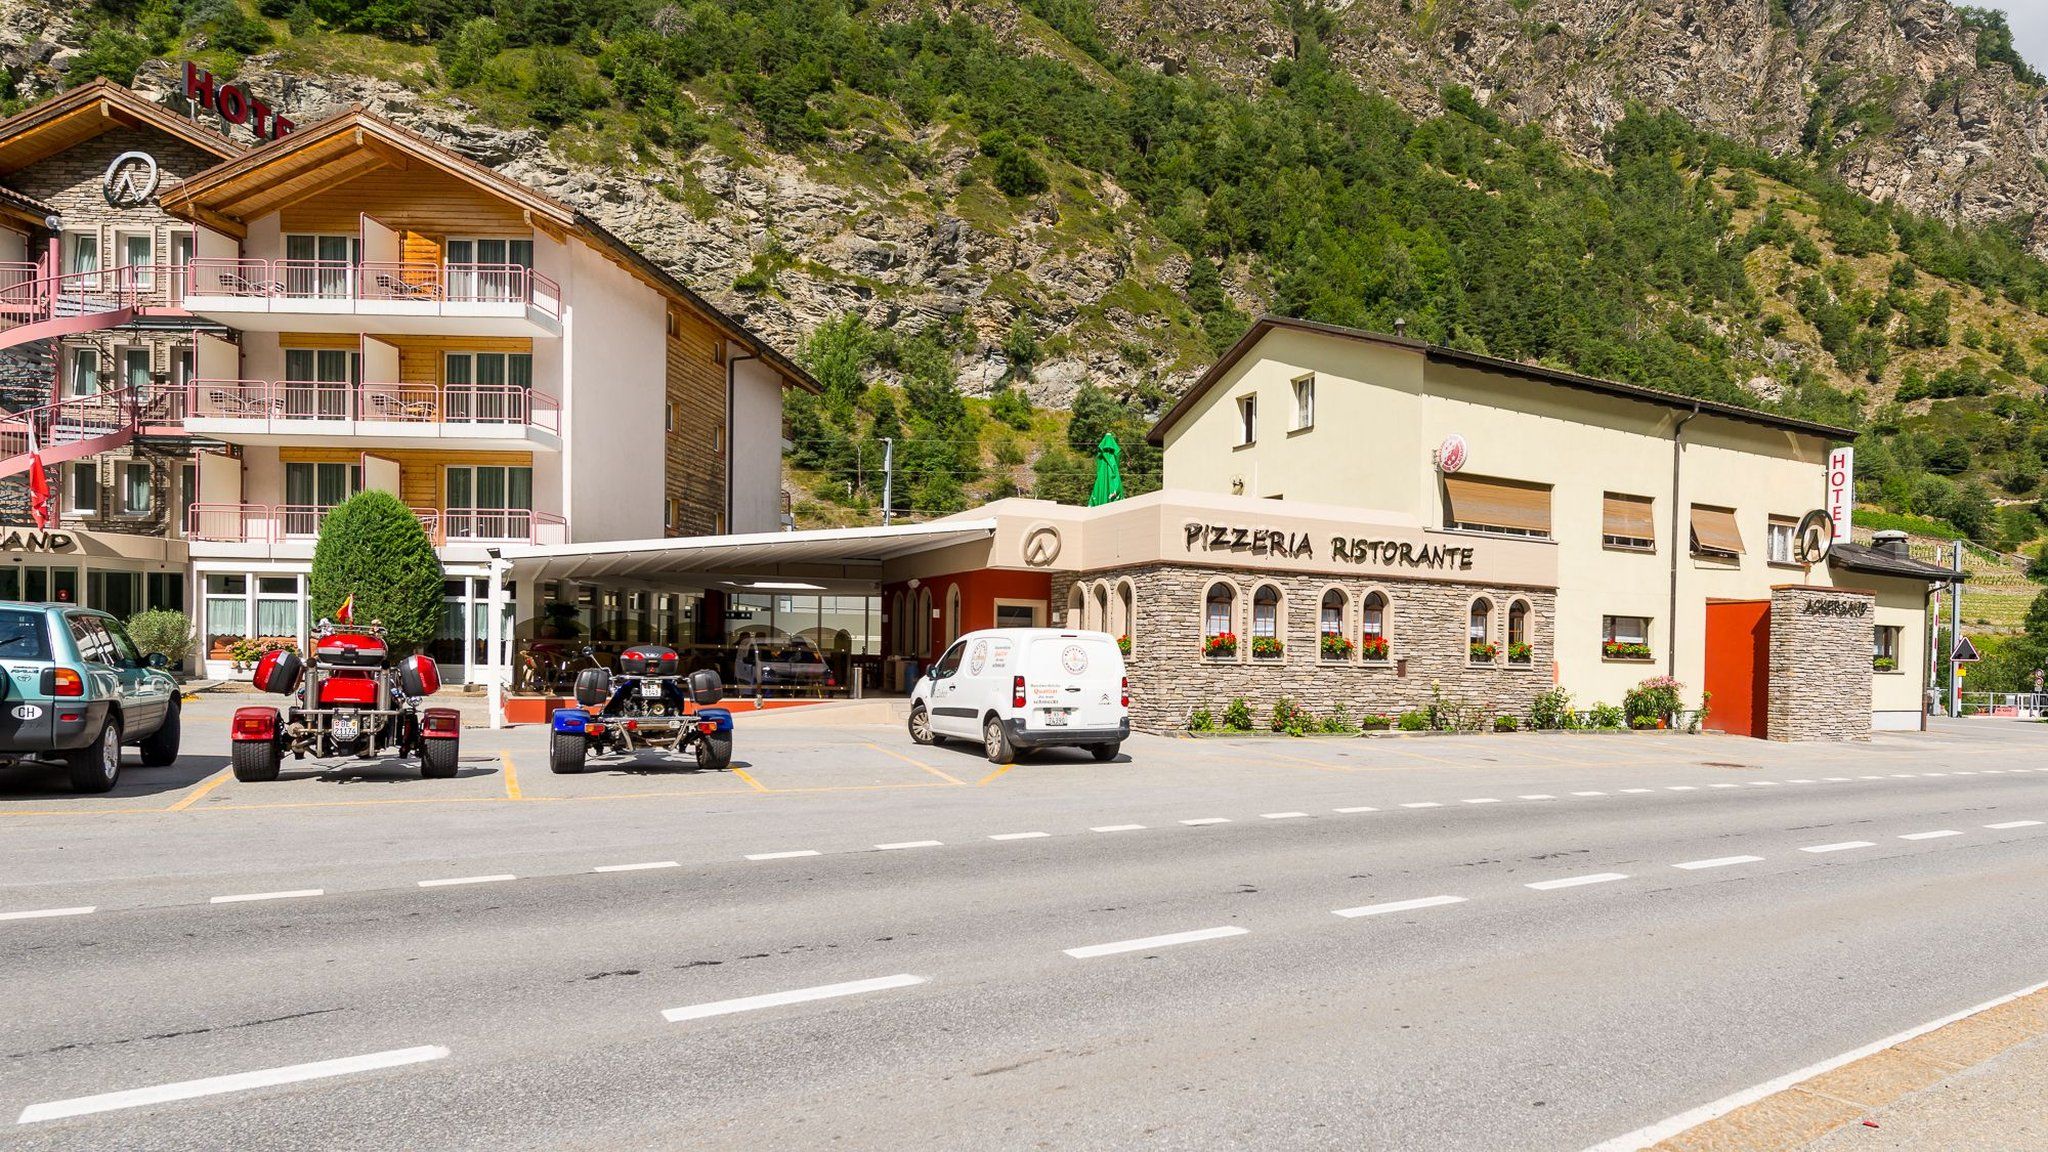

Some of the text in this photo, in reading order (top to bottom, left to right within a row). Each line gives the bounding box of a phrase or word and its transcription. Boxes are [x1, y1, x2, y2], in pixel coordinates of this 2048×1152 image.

[1831, 454, 1846, 539] HOTEL
[0, 530, 74, 551] AND
[1184, 522, 1474, 570] PIZZERIA RISTORANTE
[1803, 598, 1868, 617] ACKERSAND
[18, 707, 35, 717] CH
